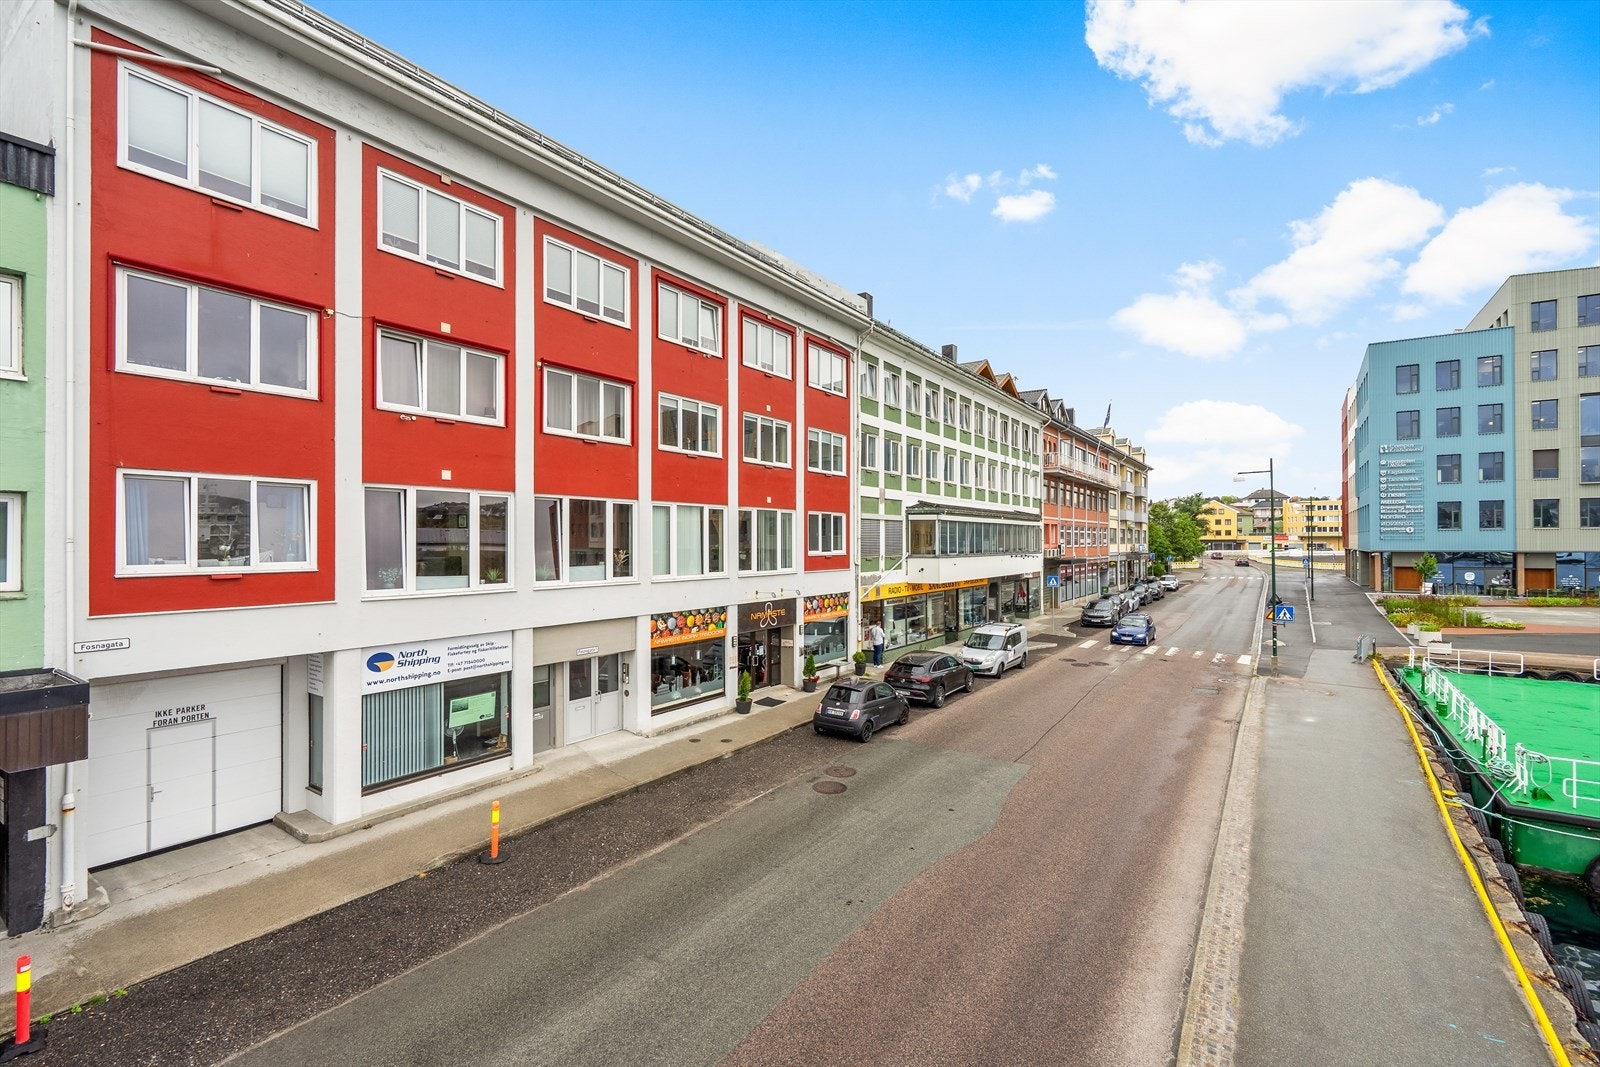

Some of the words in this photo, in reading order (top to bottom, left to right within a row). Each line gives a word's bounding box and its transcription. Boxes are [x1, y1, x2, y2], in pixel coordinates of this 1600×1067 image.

[751, 608, 786, 621] NAMASTE
[80, 641, 124, 651] Fosnagata
[398, 648, 428, 659] North
[397, 656, 441, 668] Shipping
[366, 670, 442, 687] www.northshipping.no
[154, 708, 173, 718] IKKE
[175, 703, 206, 715] PARKER
[152, 716, 179, 728] FORAN
[181, 711, 210, 723] PORTEN
